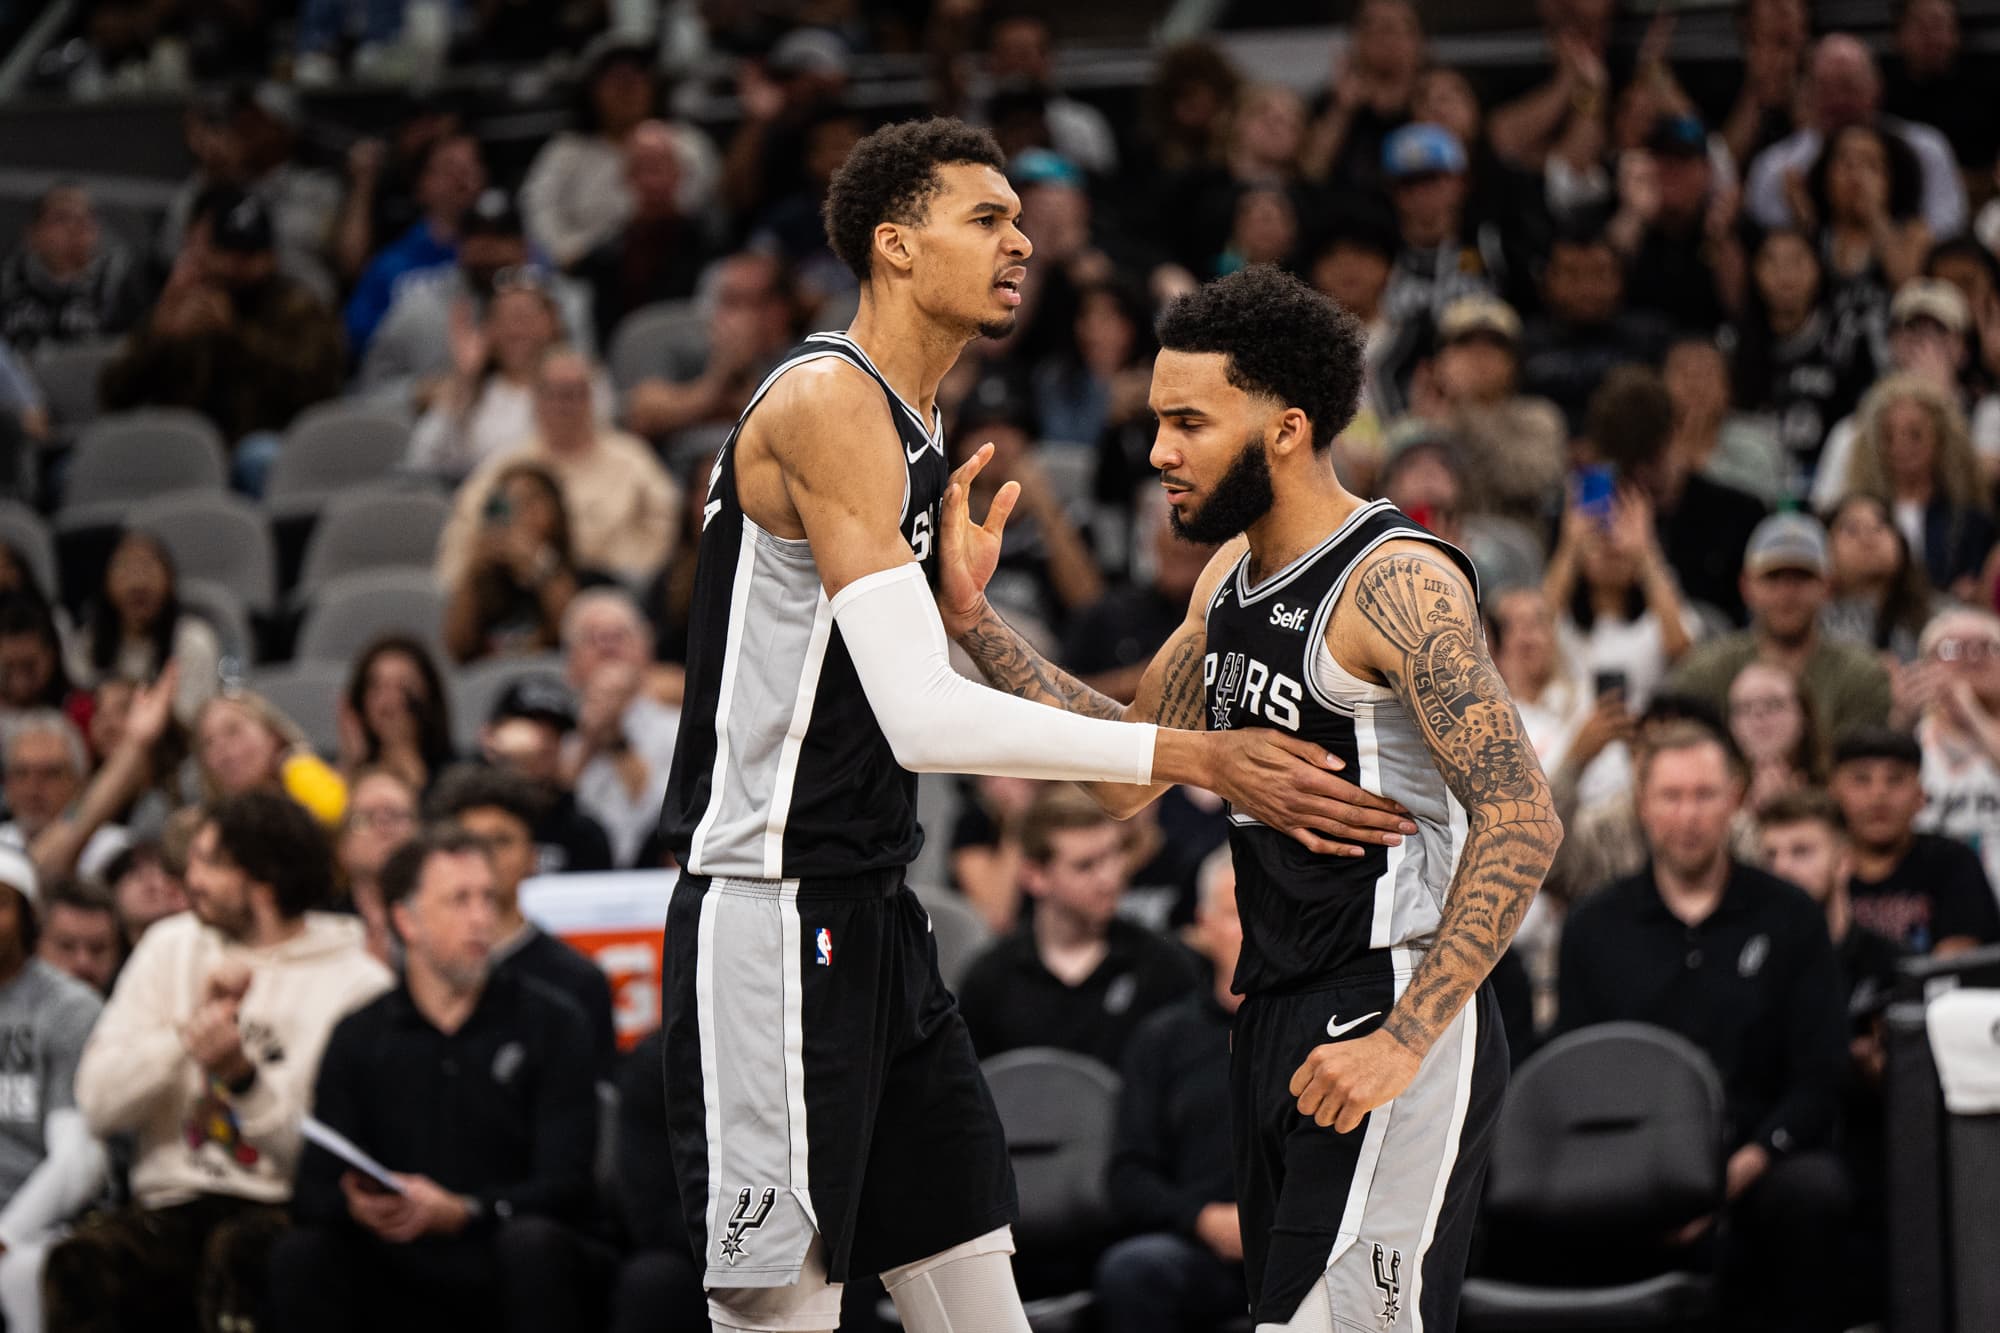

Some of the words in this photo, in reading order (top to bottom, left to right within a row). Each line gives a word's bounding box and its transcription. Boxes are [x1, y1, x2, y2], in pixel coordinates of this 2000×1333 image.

[1427, 610, 1465, 628] Gamble
[1204, 652, 1303, 732] PURS
[1416, 677, 1431, 689] 5
[1429, 712, 1452, 735] 29
